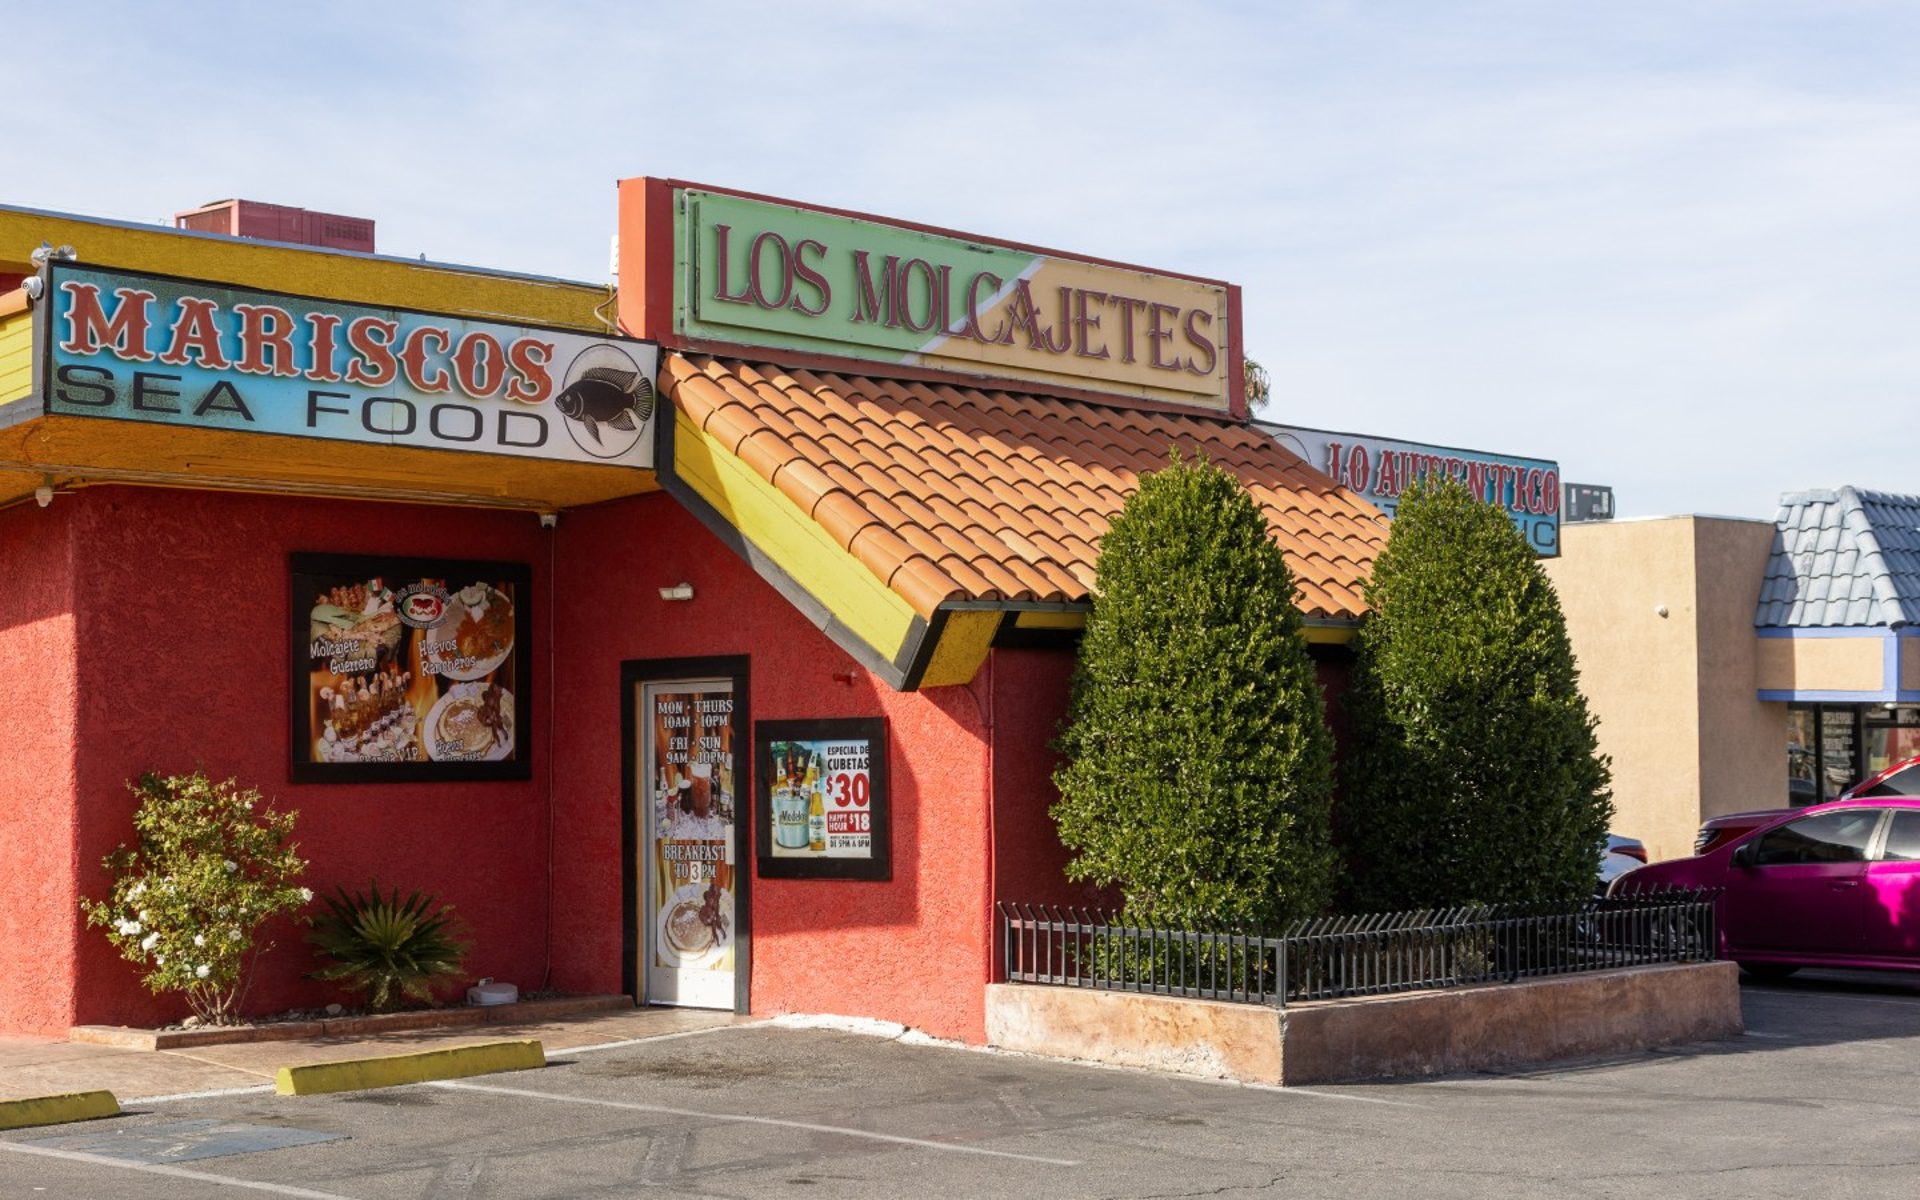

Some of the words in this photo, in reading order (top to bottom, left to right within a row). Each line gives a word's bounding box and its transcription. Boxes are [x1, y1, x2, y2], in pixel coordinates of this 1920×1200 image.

[714, 224, 832, 316] LOS
[849, 249, 1219, 377] MOLCAJETES
[60, 280, 557, 405] MARISCOS
[56, 365, 256, 422] SEA
[307, 390, 549, 449] FOOD
[1328, 443, 1370, 493] LO
[310, 639, 361, 659] Molcajete
[418, 639, 458, 658] Huevos
[330, 658, 376, 675] Guerrero
[658, 701, 683, 714] MON
[694, 700, 733, 713] THURS
[664, 716, 690, 729] 10AM
[701, 714, 728, 728] 10PM
[669, 737, 688, 750] FRI
[699, 736, 721, 749] SUN
[827, 746, 858, 756] ESPECIAL
[666, 751, 688, 764] 9AM
[698, 751, 726, 764] 10PM
[827, 758, 869, 770] CUBETAS
[826, 773, 869, 807] $30
[829, 813, 848, 822] HAPPY
[829, 822, 848, 831] HOUR
[664, 844, 725, 860] BREAKFAST
[676, 863, 688, 878] TO
[691, 863, 699, 880] 3
[701, 863, 716, 878] PM
